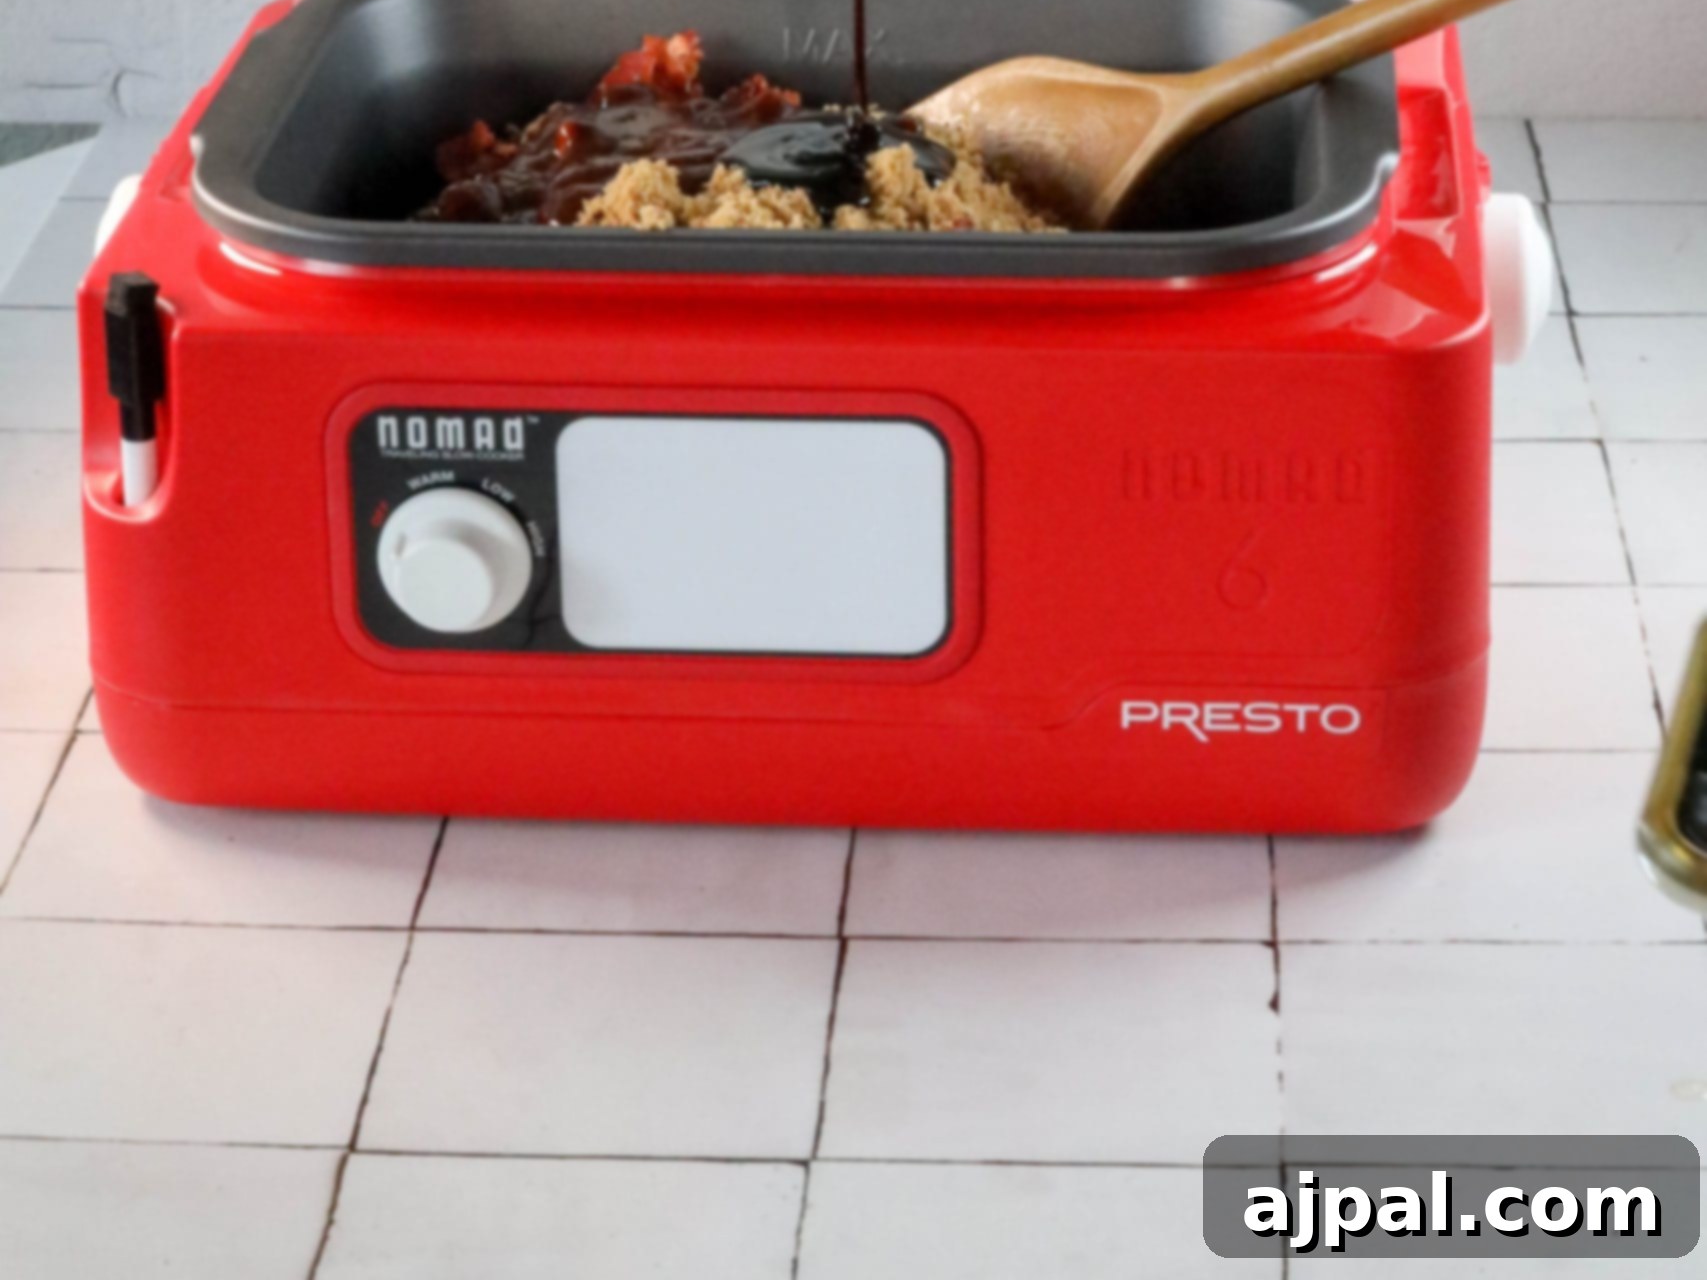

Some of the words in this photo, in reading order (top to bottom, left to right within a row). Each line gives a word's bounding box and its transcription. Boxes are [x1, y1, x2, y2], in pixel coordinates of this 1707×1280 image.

[406, 470, 455, 491] WARM
[480, 477, 515, 503] LOW
[1120, 700, 1361, 743] PRESTO
